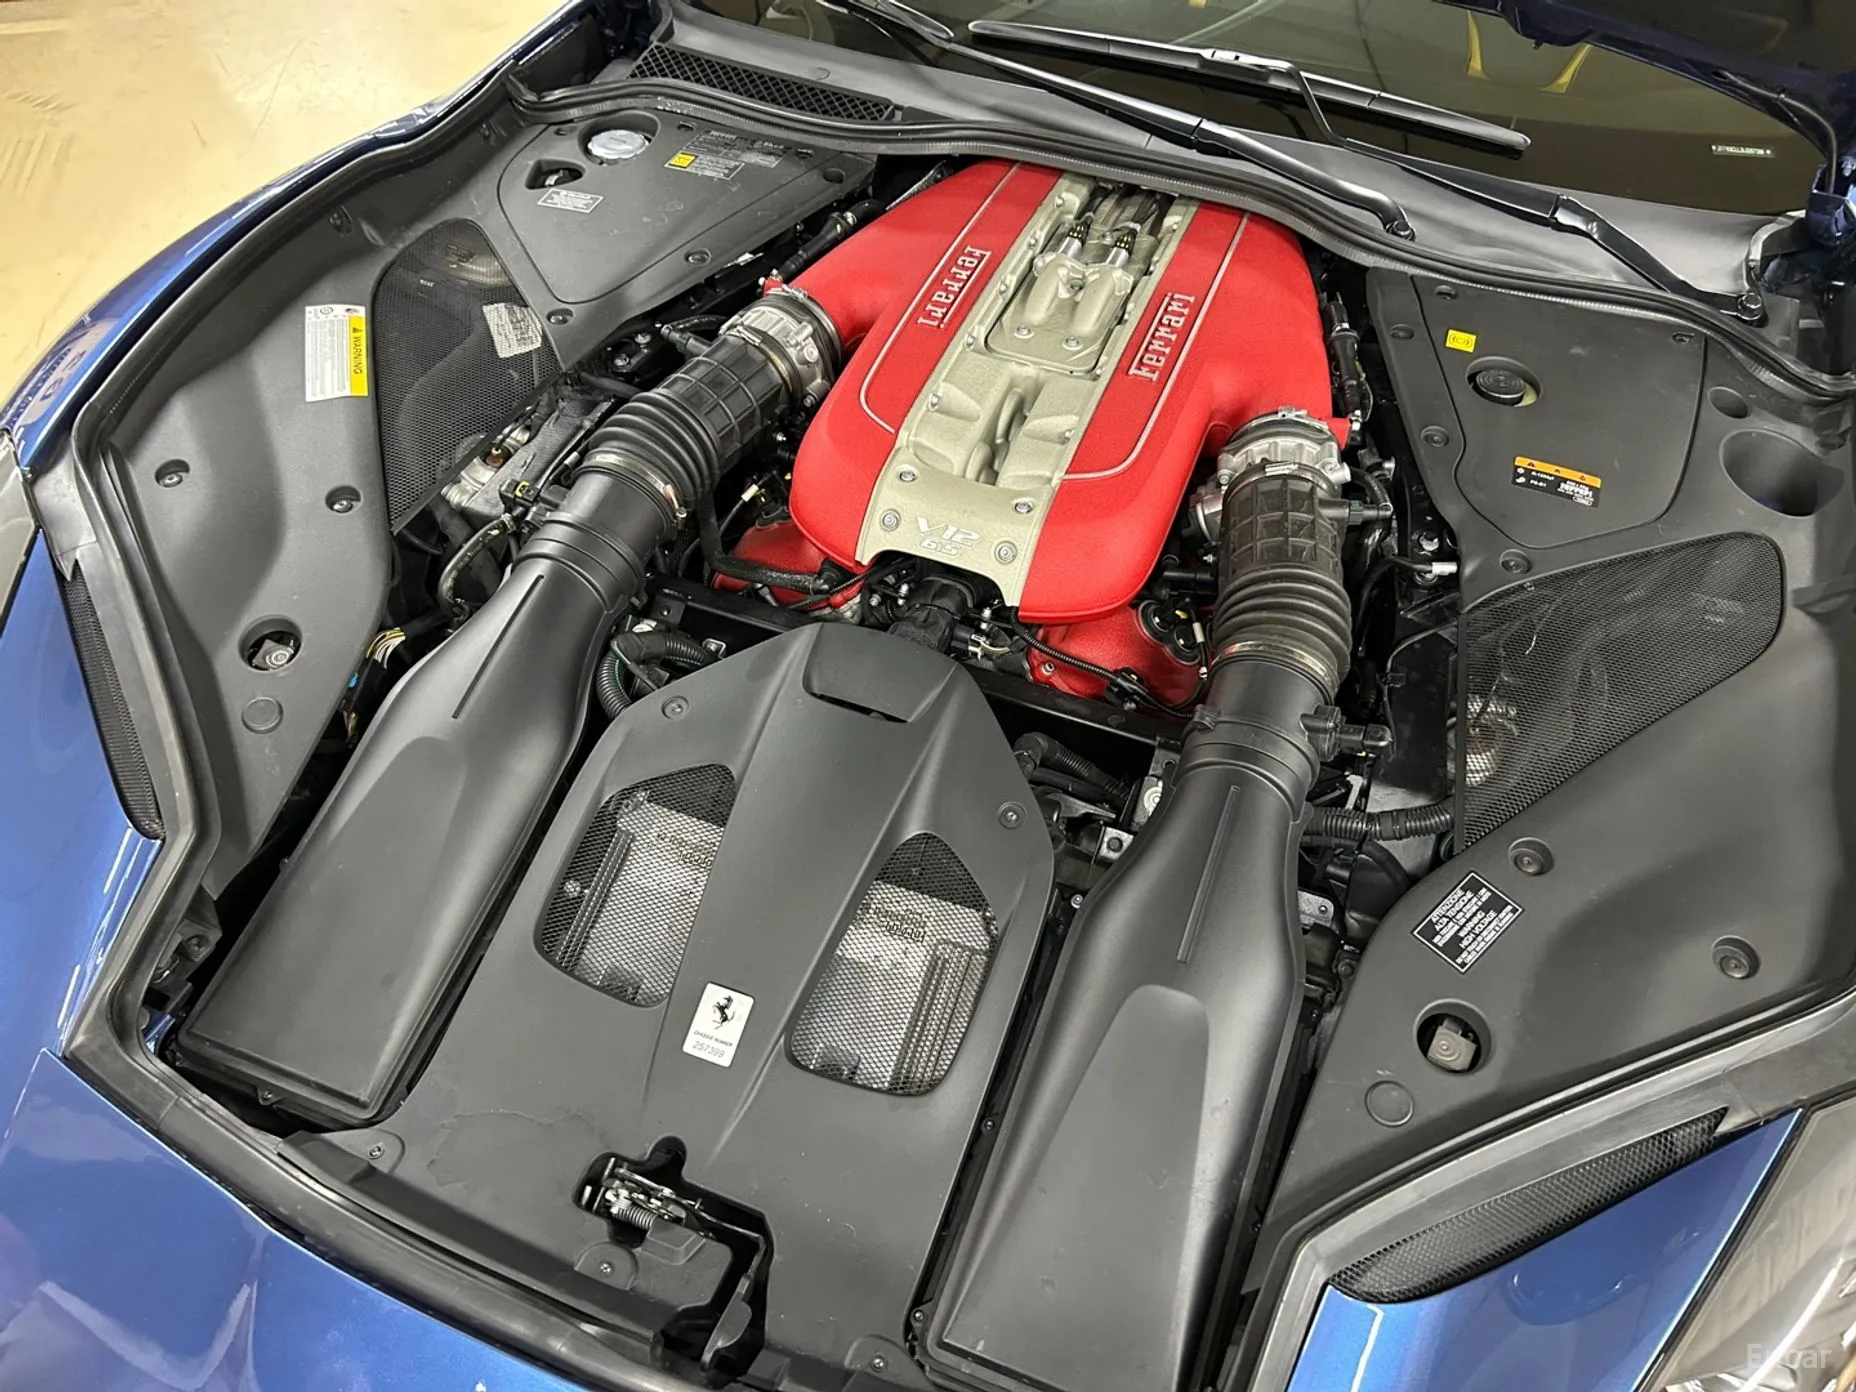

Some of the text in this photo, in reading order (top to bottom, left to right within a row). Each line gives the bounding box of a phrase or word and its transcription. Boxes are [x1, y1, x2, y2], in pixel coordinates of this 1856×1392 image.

[917, 245, 991, 329] Ferrari
[352, 336, 363, 375] WARNING
[1128, 292, 1195, 382] Ferrari
[917, 516, 980, 548] V12
[1430, 888, 1465, 924] ATTENZIONE
[1434, 916, 1450, 931] ALTA
[1445, 889, 1475, 919] TENSIONE
[1457, 909, 1486, 938] WARNING
[1458, 931, 1476, 949] HIGH
[1471, 909, 1498, 935] VOLTAGE
